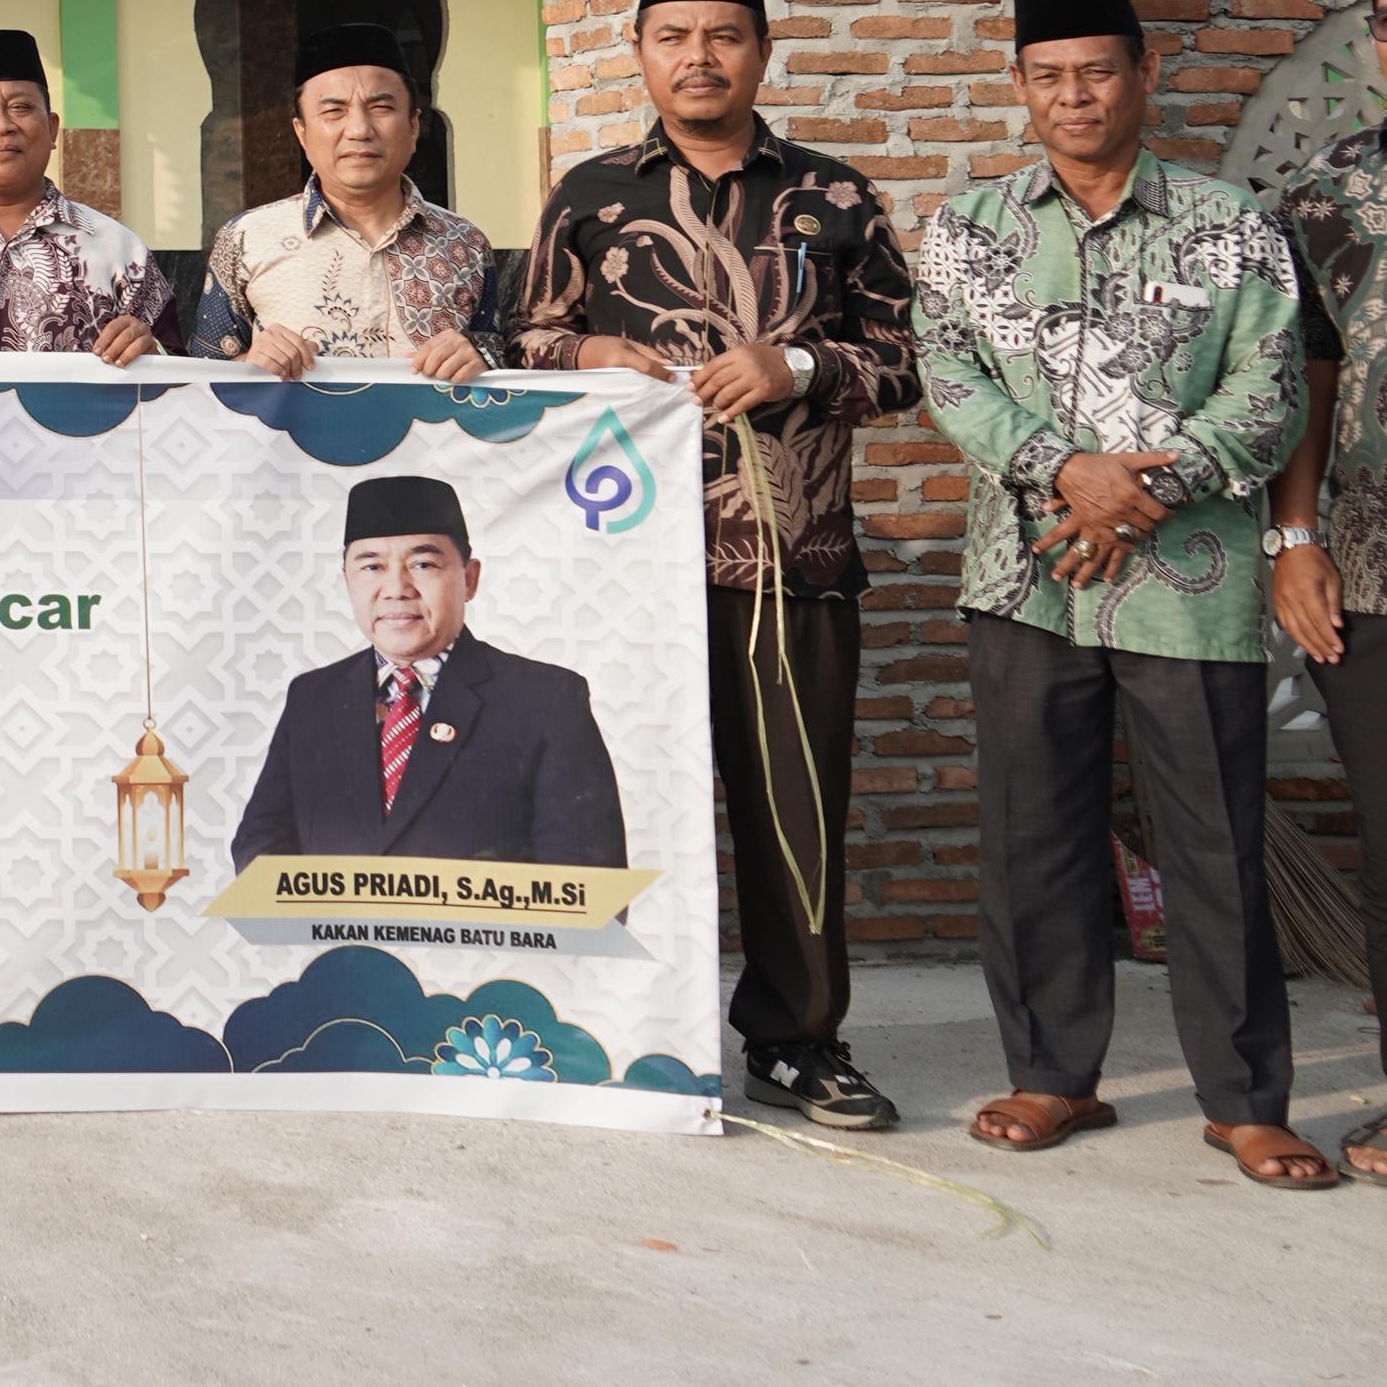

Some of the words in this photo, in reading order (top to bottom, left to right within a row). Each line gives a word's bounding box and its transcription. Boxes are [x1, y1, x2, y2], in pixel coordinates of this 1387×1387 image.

[276, 871, 346, 897] AGUS
[353, 873, 449, 905] PRIADI,
[456, 876, 587, 910] S.Ag.,M.Si
[311, 923, 369, 941] KAKAN
[373, 925, 456, 944] KEMENAG
[460, 928, 505, 946] BATU
[510, 930, 557, 949] BARA
